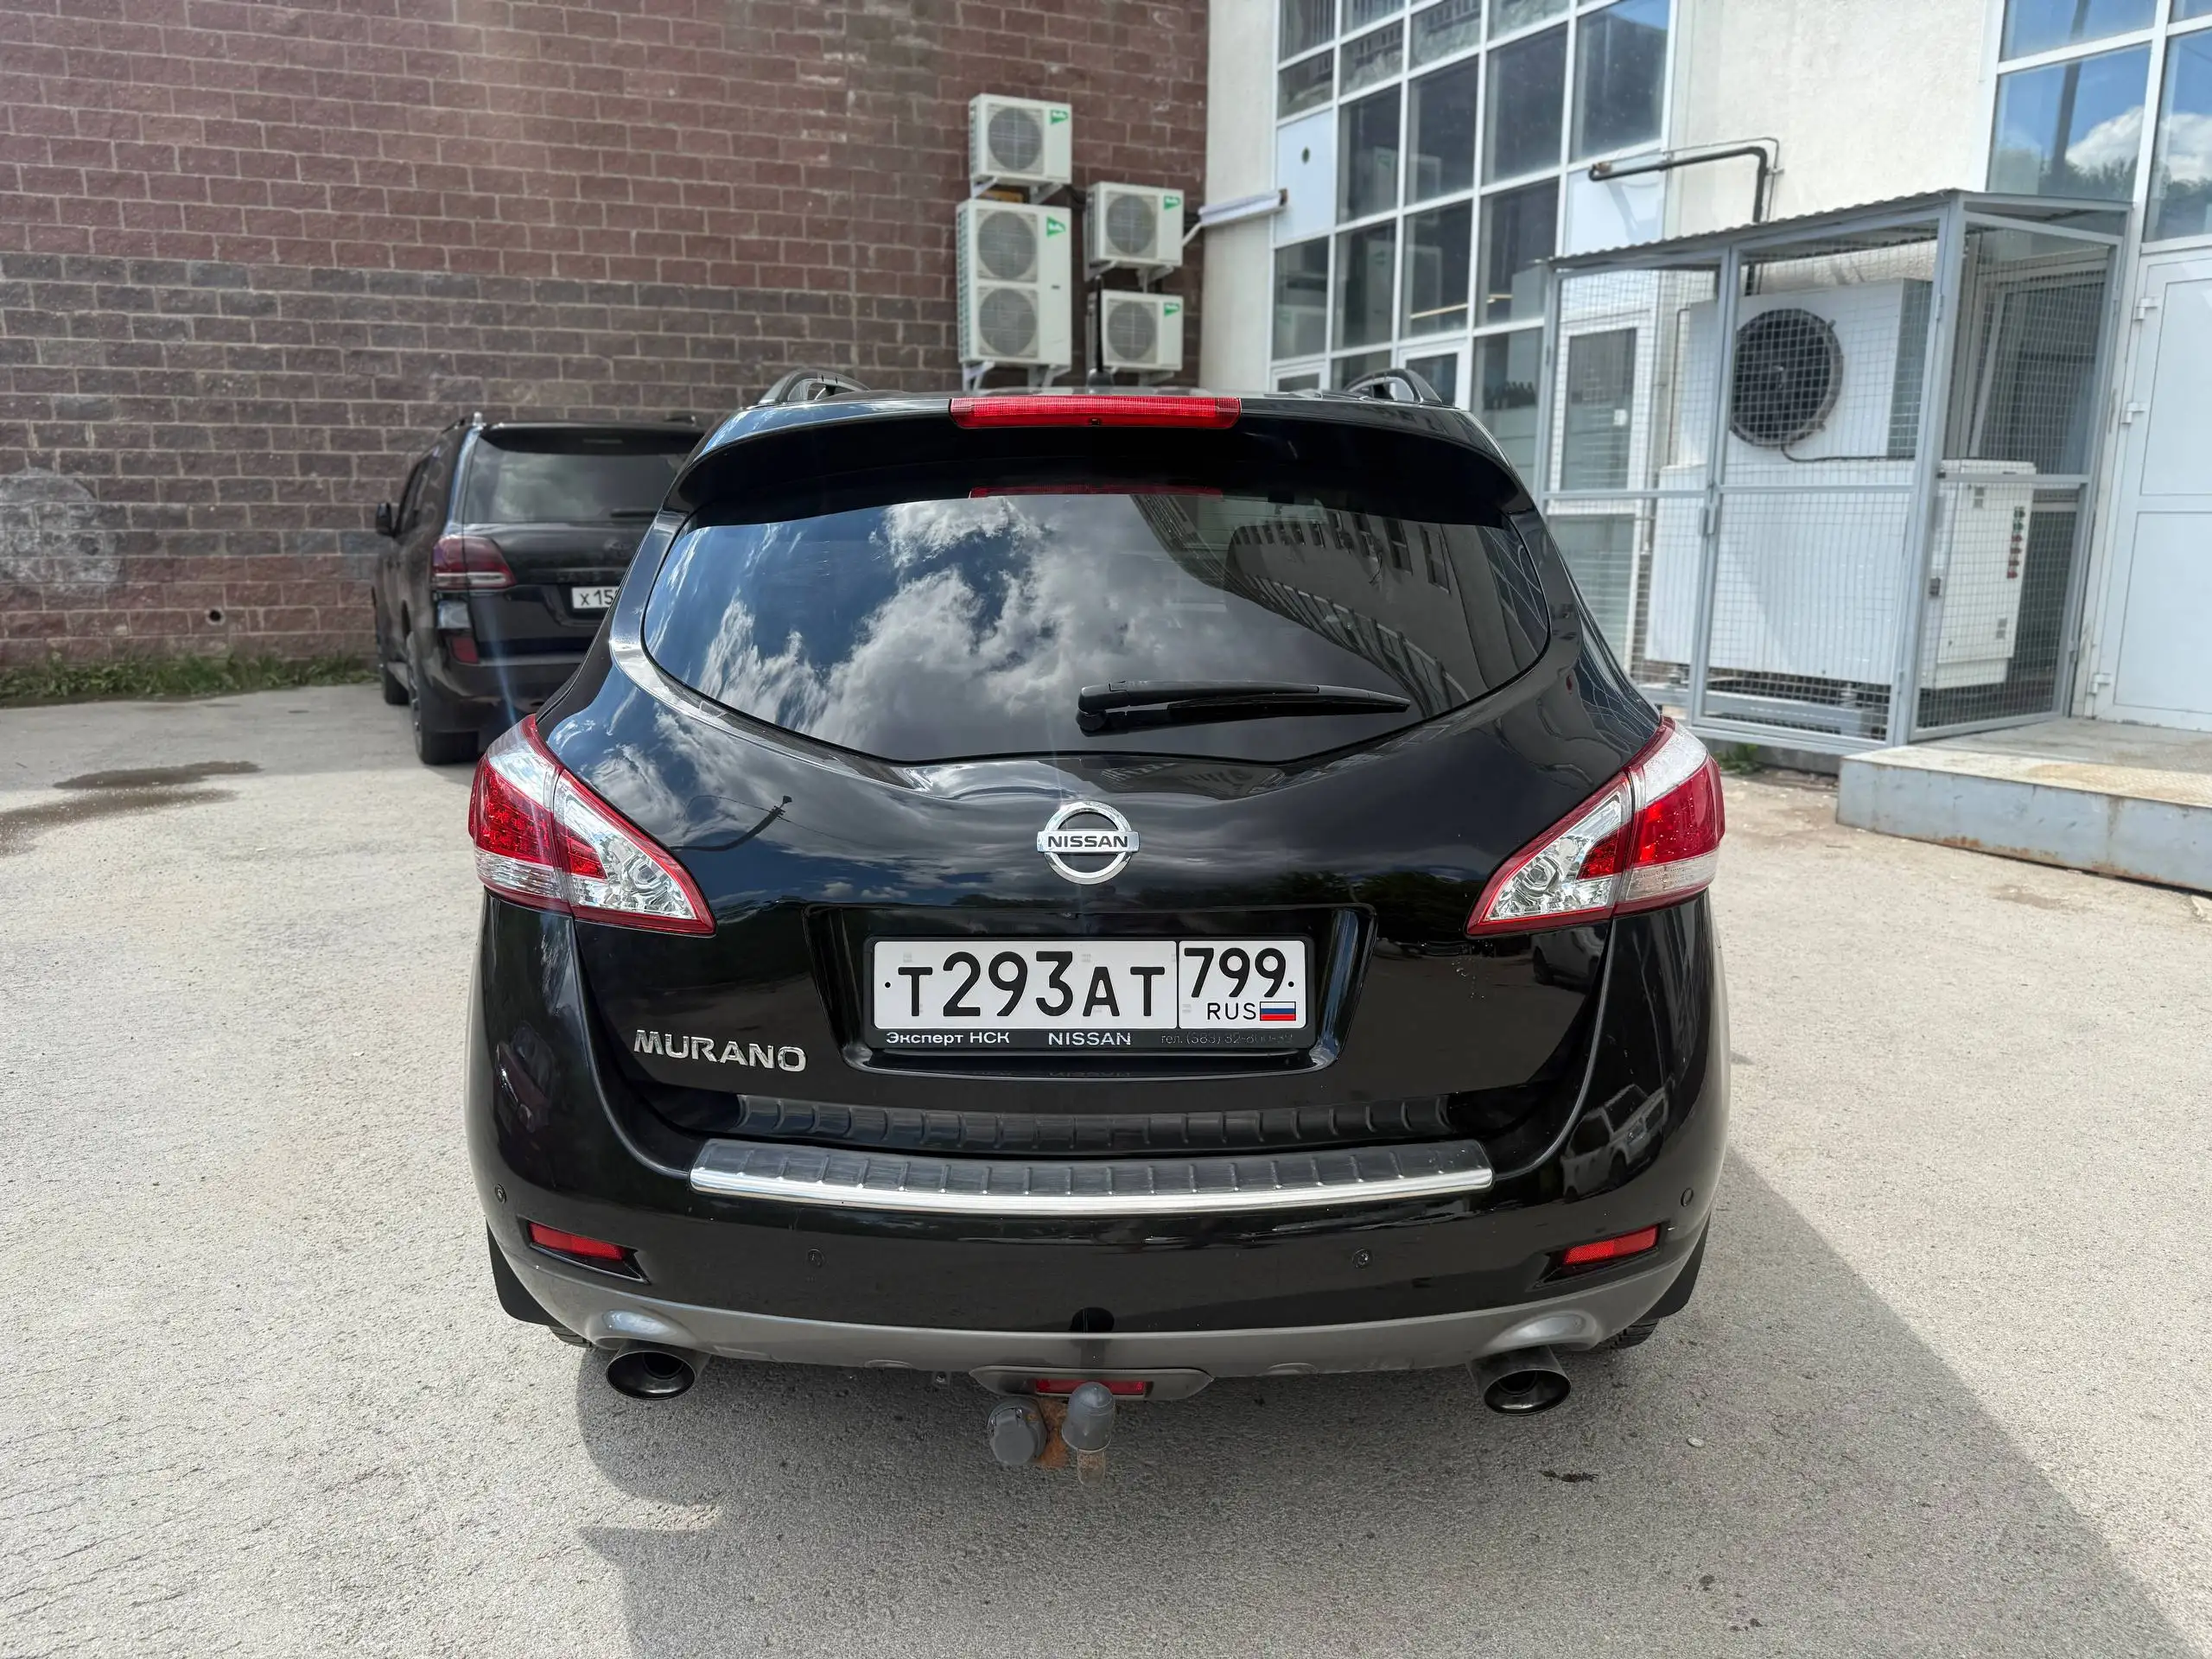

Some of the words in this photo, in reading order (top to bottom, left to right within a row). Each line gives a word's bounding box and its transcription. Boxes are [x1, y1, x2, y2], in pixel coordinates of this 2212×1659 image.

[1047, 836, 1128, 848] NISSAN
[1184, 947, 1287, 998] 799
[1207, 1002, 1256, 1020] RUS
[886, 1032, 963, 1046] Эксперт
[969, 1032, 1010, 1044] НСК
[1048, 1032, 1132, 1046] NISSAN
[633, 1029, 807, 1072] MURANO
